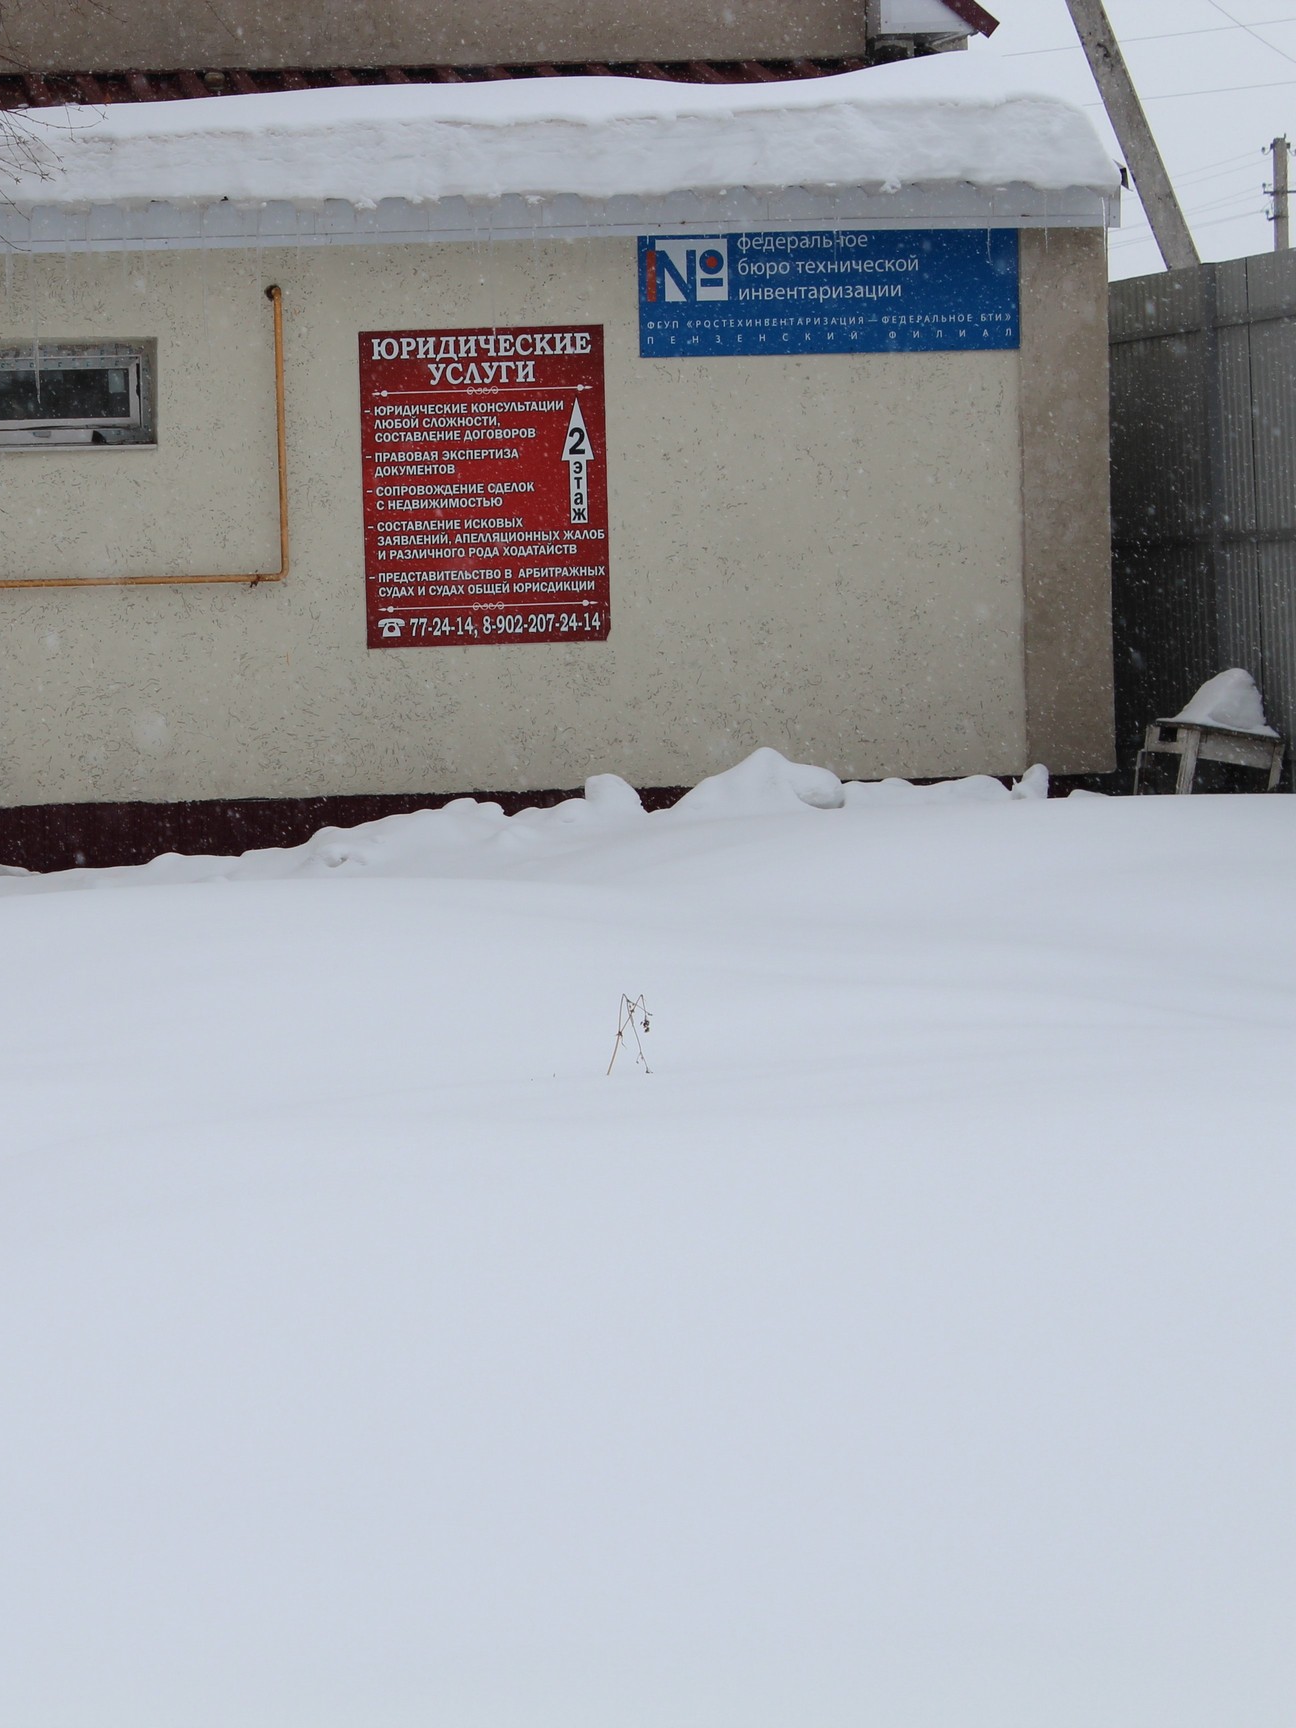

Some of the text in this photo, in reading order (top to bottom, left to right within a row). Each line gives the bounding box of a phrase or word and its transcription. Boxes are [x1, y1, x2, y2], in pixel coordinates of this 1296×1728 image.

[737, 255, 920, 278] бюро технической
[738, 284, 903, 302] инвентаризации
[647, 313, 1012, 329] ФГУП «РОСТЕХИНВЕНТАРИЗАЦИЯ ФЕДЕРАЛЬНОЕ БТИ»
[646, 327, 1012, 345] ПЕНЗЕНСКИЙ ФИЛИАЛ
[371, 332, 592, 361] ЮРИДИЧЕСКИЕ
[428, 361, 535, 385] УСЛУГИ
[374, 400, 564, 417] ЮРИДИЧЕСКИЕ КОНСУЛЬТАЦИИ
[374, 416, 501, 429] ЛЮБОЙ СЛОЖНОСТИ,
[375, 428, 536, 443] СОСТАВЛЕНИЕ ДОГОВОРОВ
[568, 427, 586, 455] 2
[375, 449, 519, 463] ПРАВОВАЯ ЭКСПЕРТИЗА
[375, 465, 455, 478] ДОКУМЕНТОВ
[376, 482, 534, 497] СОПРОВОЖДЕНИЕ СДЕЛОК
[377, 497, 503, 510] С НЕДВИЖИМОСТЬЮ
[377, 518, 523, 532] СОСТАВЛЕНИЕ ИСКОВЫХ
[378, 530, 604, 546] ЗАЯВЛЕНИЙ, АПЕЛЛЯЦИОННЫХ ЖАЛОБ
[378, 544, 577, 560] И РАЗЛИЧНОГО РОДА ХОДАТАЙСТВ
[378, 566, 605, 584] ПРЕДСТАВИТЕЛЬСТВО В АРБИТРАЖНЫХ
[379, 581, 595, 598] СУДАХ И СУДАХ ОБЩЕЙ ЮРИСДИКЦИИ
[410, 612, 601, 638] 77-24-14, 8-902-207-24-14
